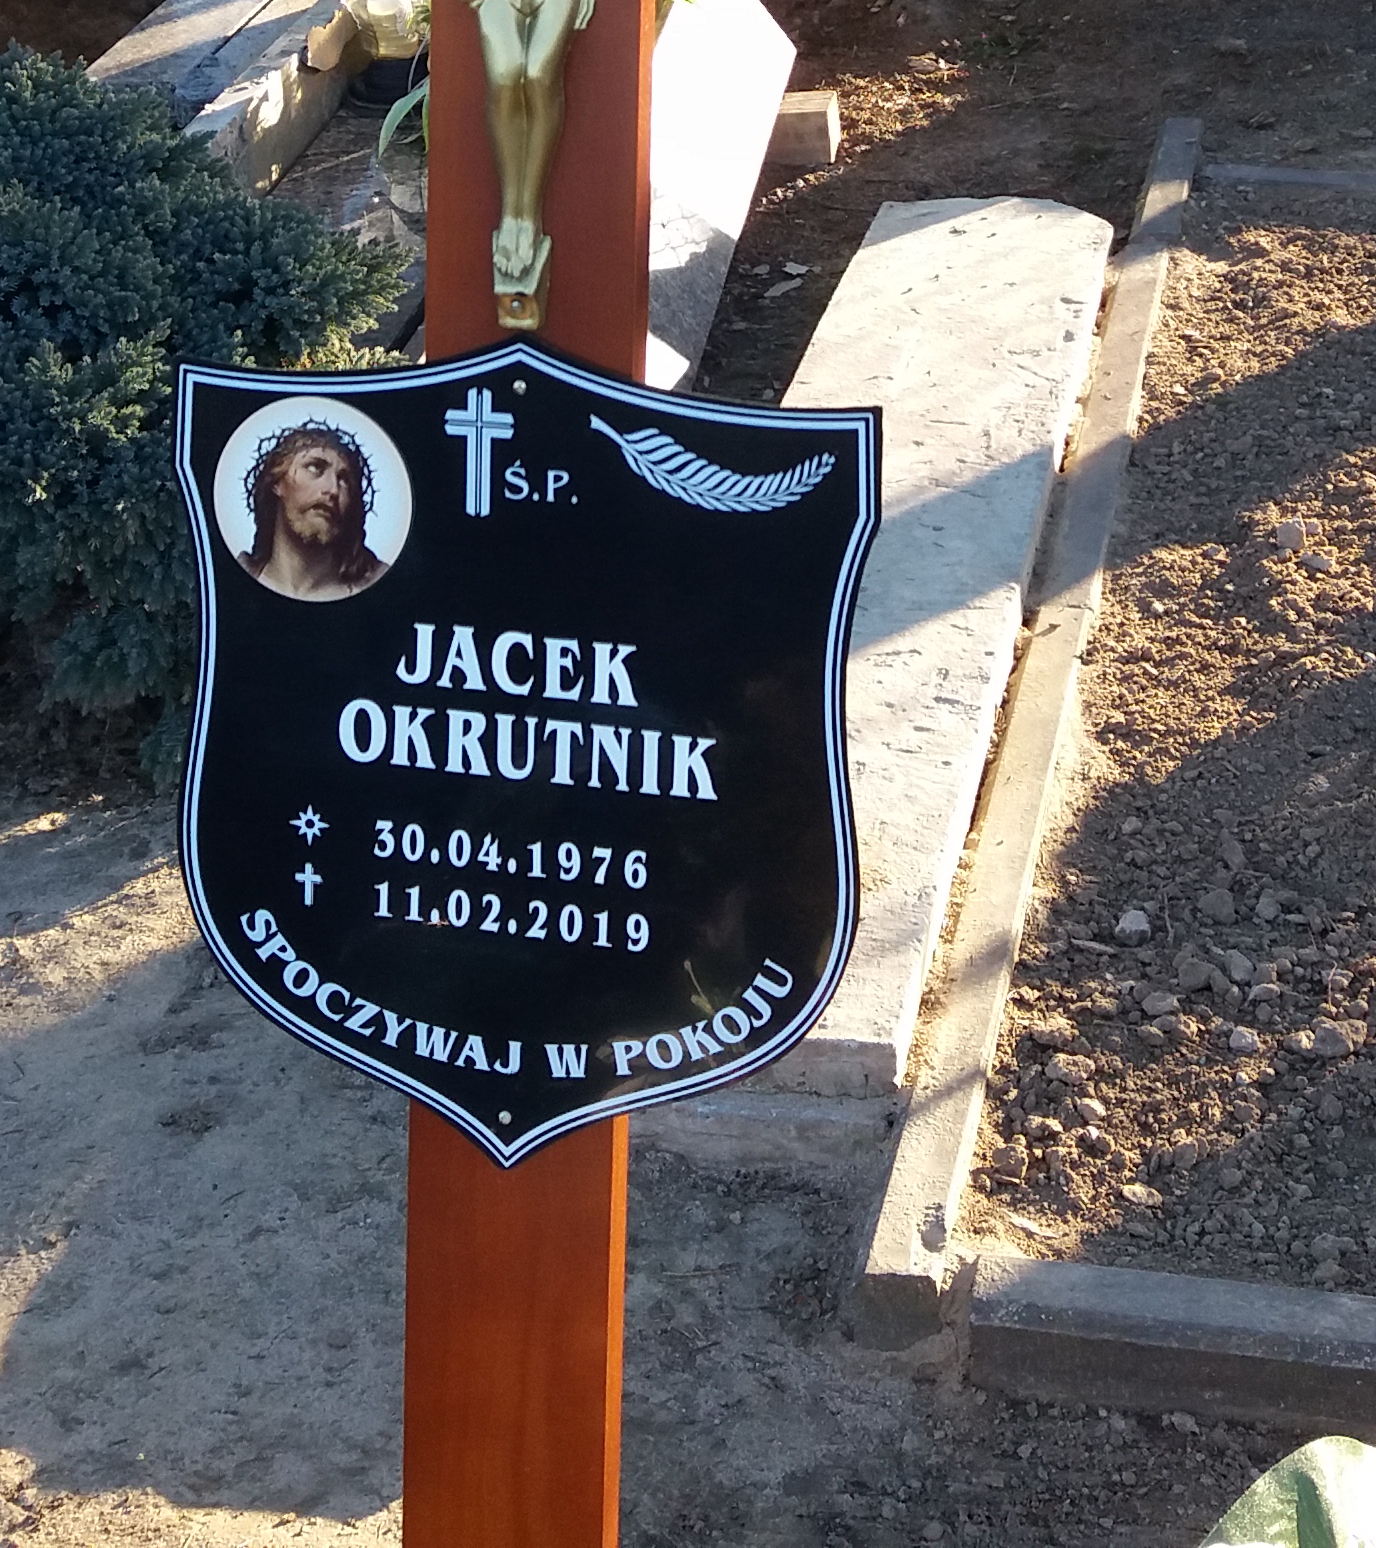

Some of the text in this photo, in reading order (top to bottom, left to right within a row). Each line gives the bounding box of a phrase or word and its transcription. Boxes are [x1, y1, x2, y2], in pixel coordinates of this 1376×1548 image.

[503, 459, 580, 505] Ś.P.
[395, 621, 639, 709] JACEK
[338, 697, 718, 802] OKRUTNIK
[372, 818, 649, 890] 30.04.1976
[372, 881, 652, 953] 11.02.2019
[240, 906, 795, 1080] SPOCZYWAJ W POKOJU
